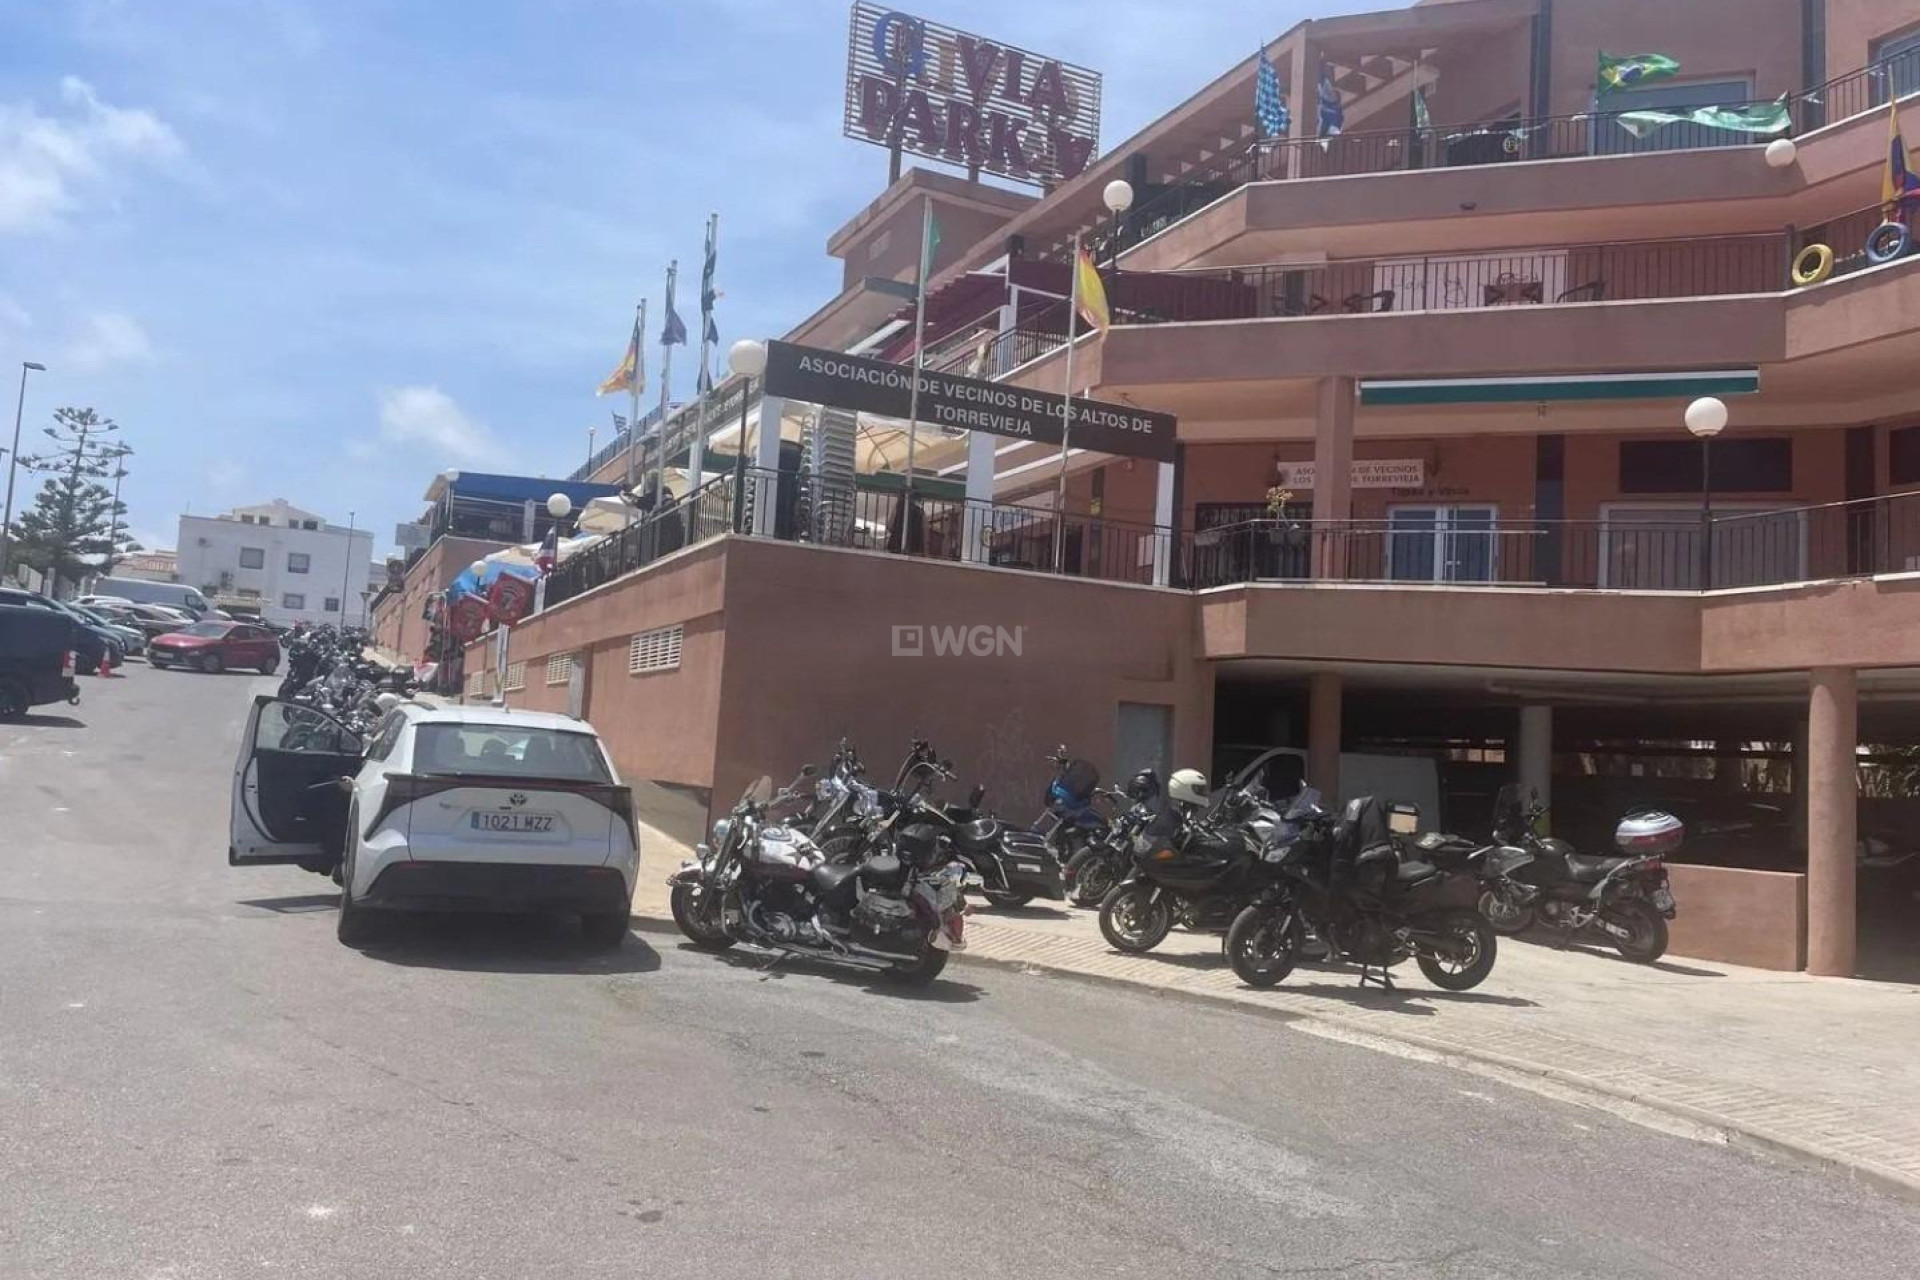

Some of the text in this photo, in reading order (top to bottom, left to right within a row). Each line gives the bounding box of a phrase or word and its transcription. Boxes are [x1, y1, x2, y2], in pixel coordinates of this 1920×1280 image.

[859, 75, 1033, 180] PARK
[799, 355, 1153, 434] ASOCIACIÓN DE VECINOS DE LOS ALTOS DE
[934, 404, 1033, 435] TORREVIEJA
[1361, 475, 1420, 483] TORREVIEJA
[1373, 464, 1418, 474] VECINOS
[483, 814, 519, 829] 1021
